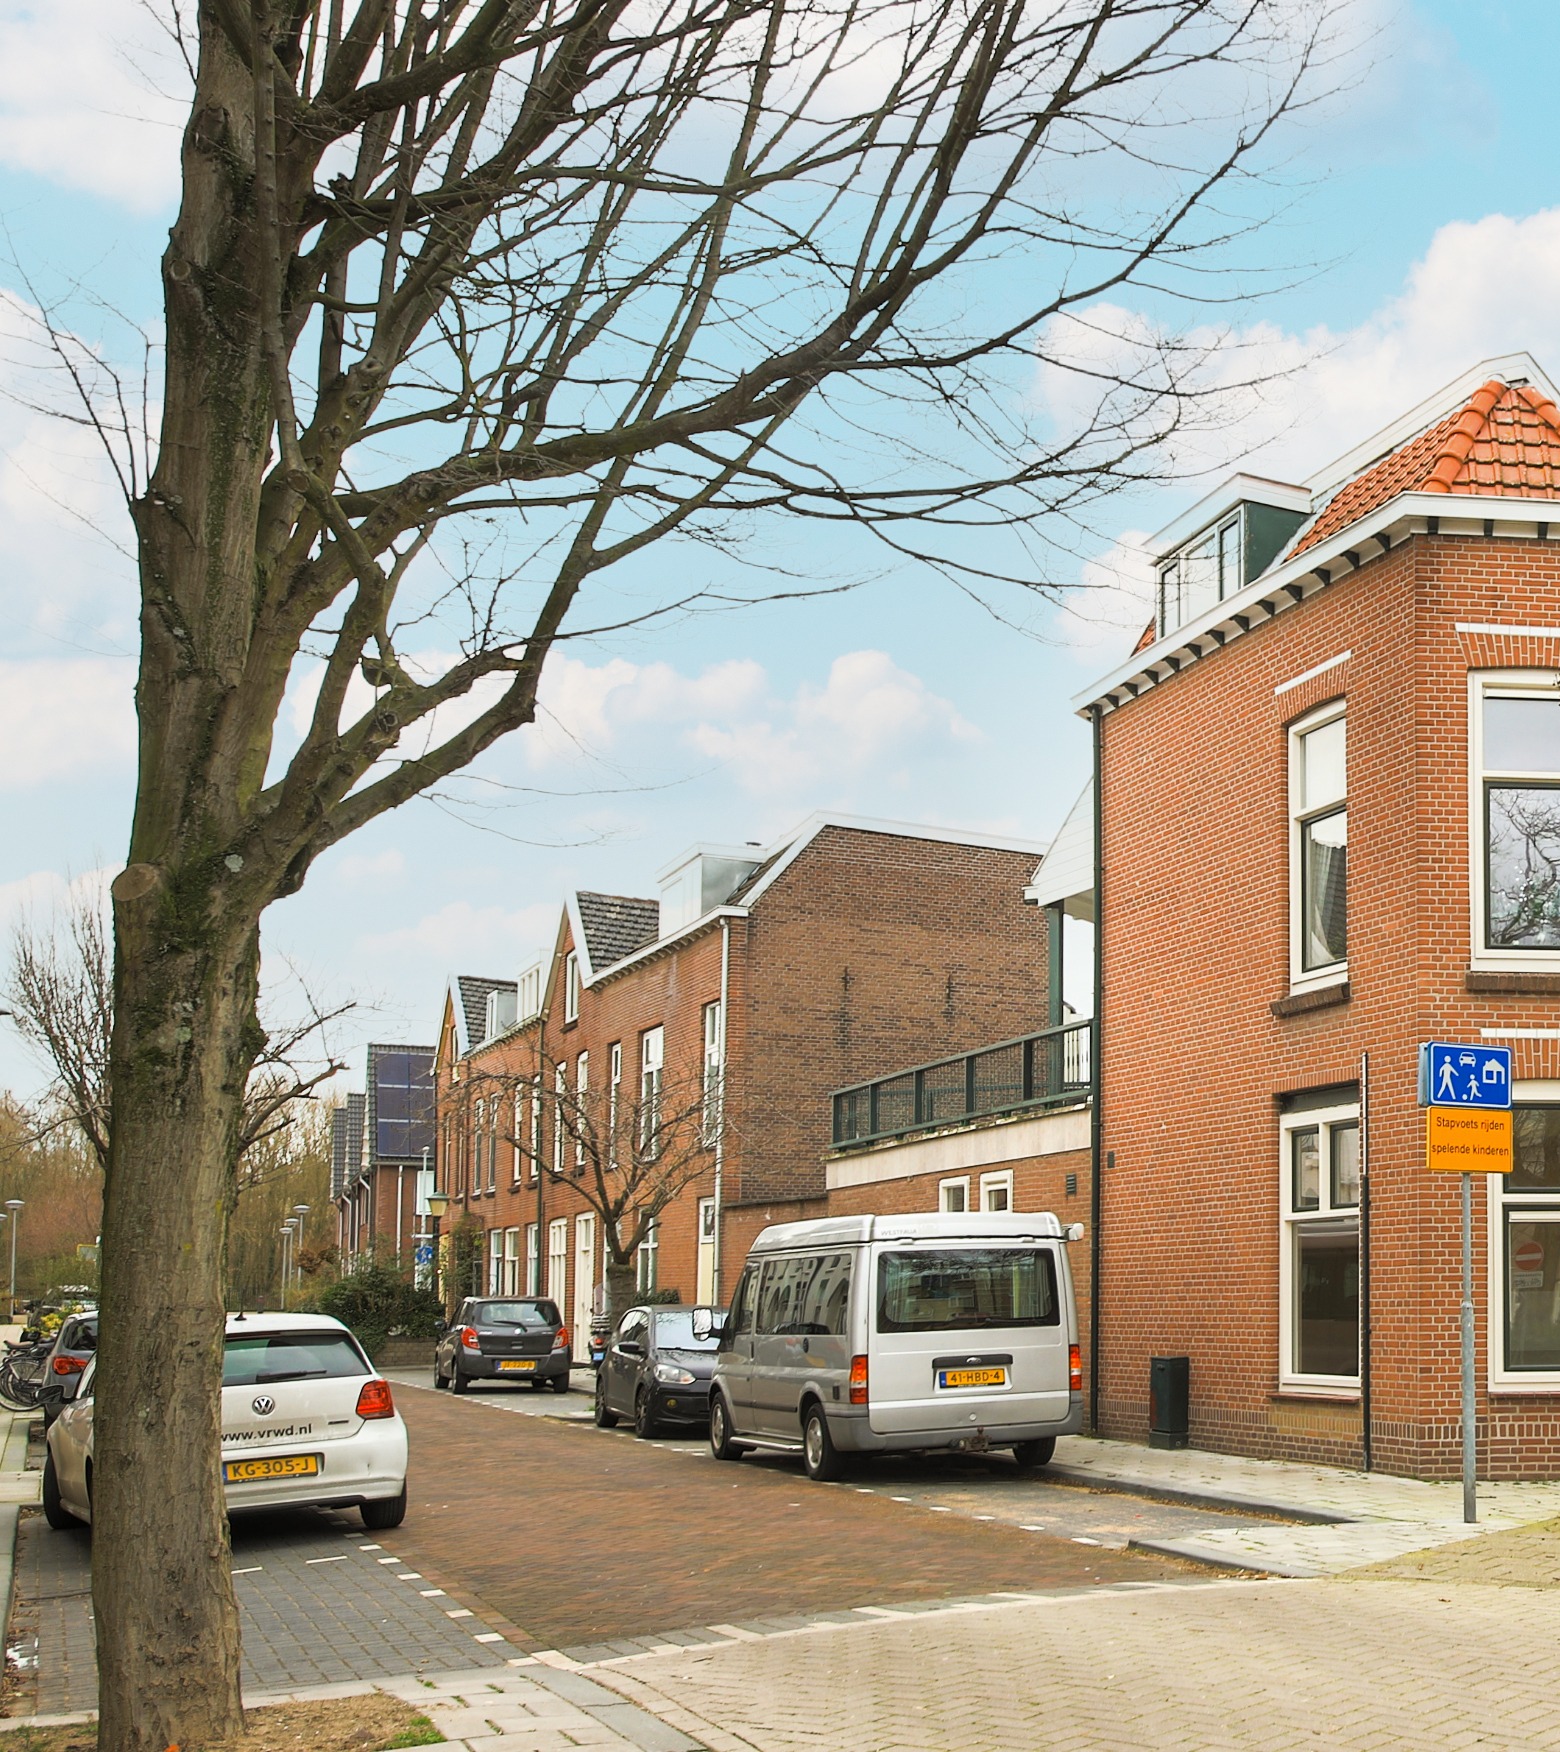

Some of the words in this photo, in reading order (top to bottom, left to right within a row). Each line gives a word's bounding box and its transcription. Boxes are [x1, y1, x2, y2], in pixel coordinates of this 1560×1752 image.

[1436, 1116, 1479, 1129] Stapvoets
[1481, 1119, 1505, 1133] rijden
[1431, 1143, 1471, 1155] spelende
[1473, 1144, 1509, 1156] kinderen
[950, 1371, 1001, 1383] 41-HBD-4
[232, 1458, 310, 1478] KG-305-J
